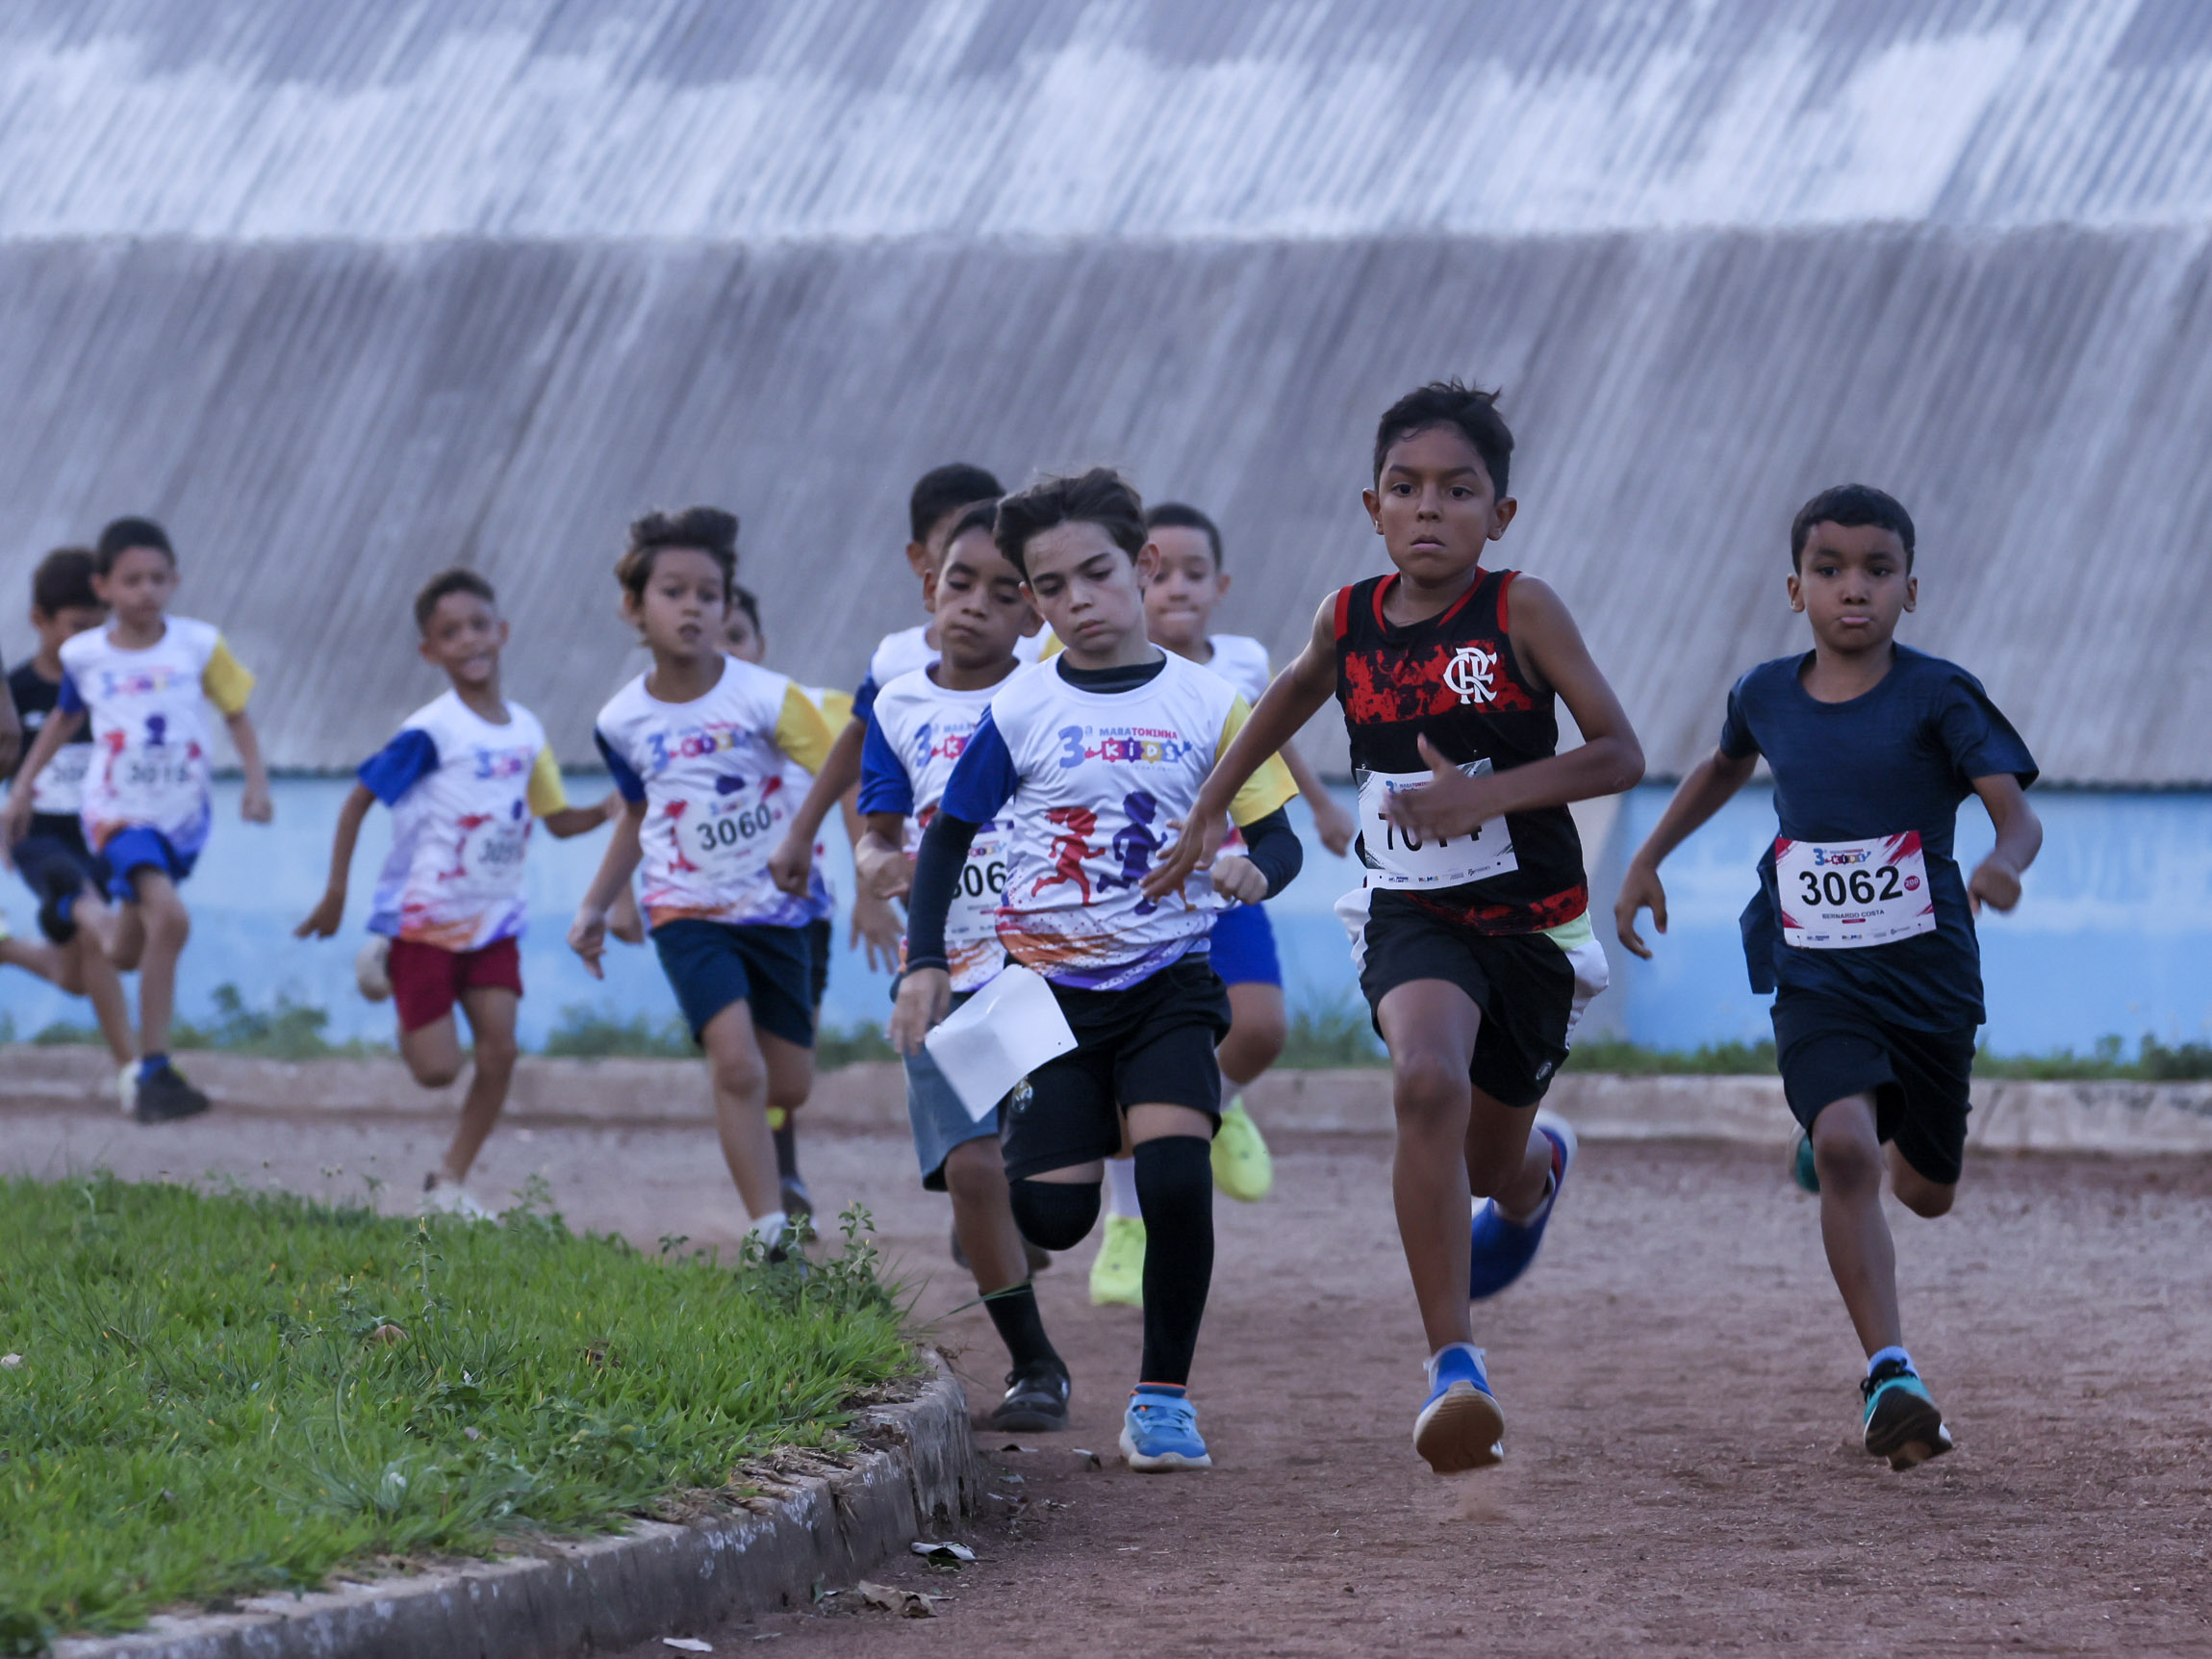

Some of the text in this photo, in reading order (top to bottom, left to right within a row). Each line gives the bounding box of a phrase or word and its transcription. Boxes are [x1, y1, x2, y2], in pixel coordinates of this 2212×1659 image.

[1099, 727, 1178, 739] MARATONINHA
[696, 803, 772, 852] 3060
[1799, 866, 1903, 906] 3062
[1861, 908, 1885, 918] COSTA
